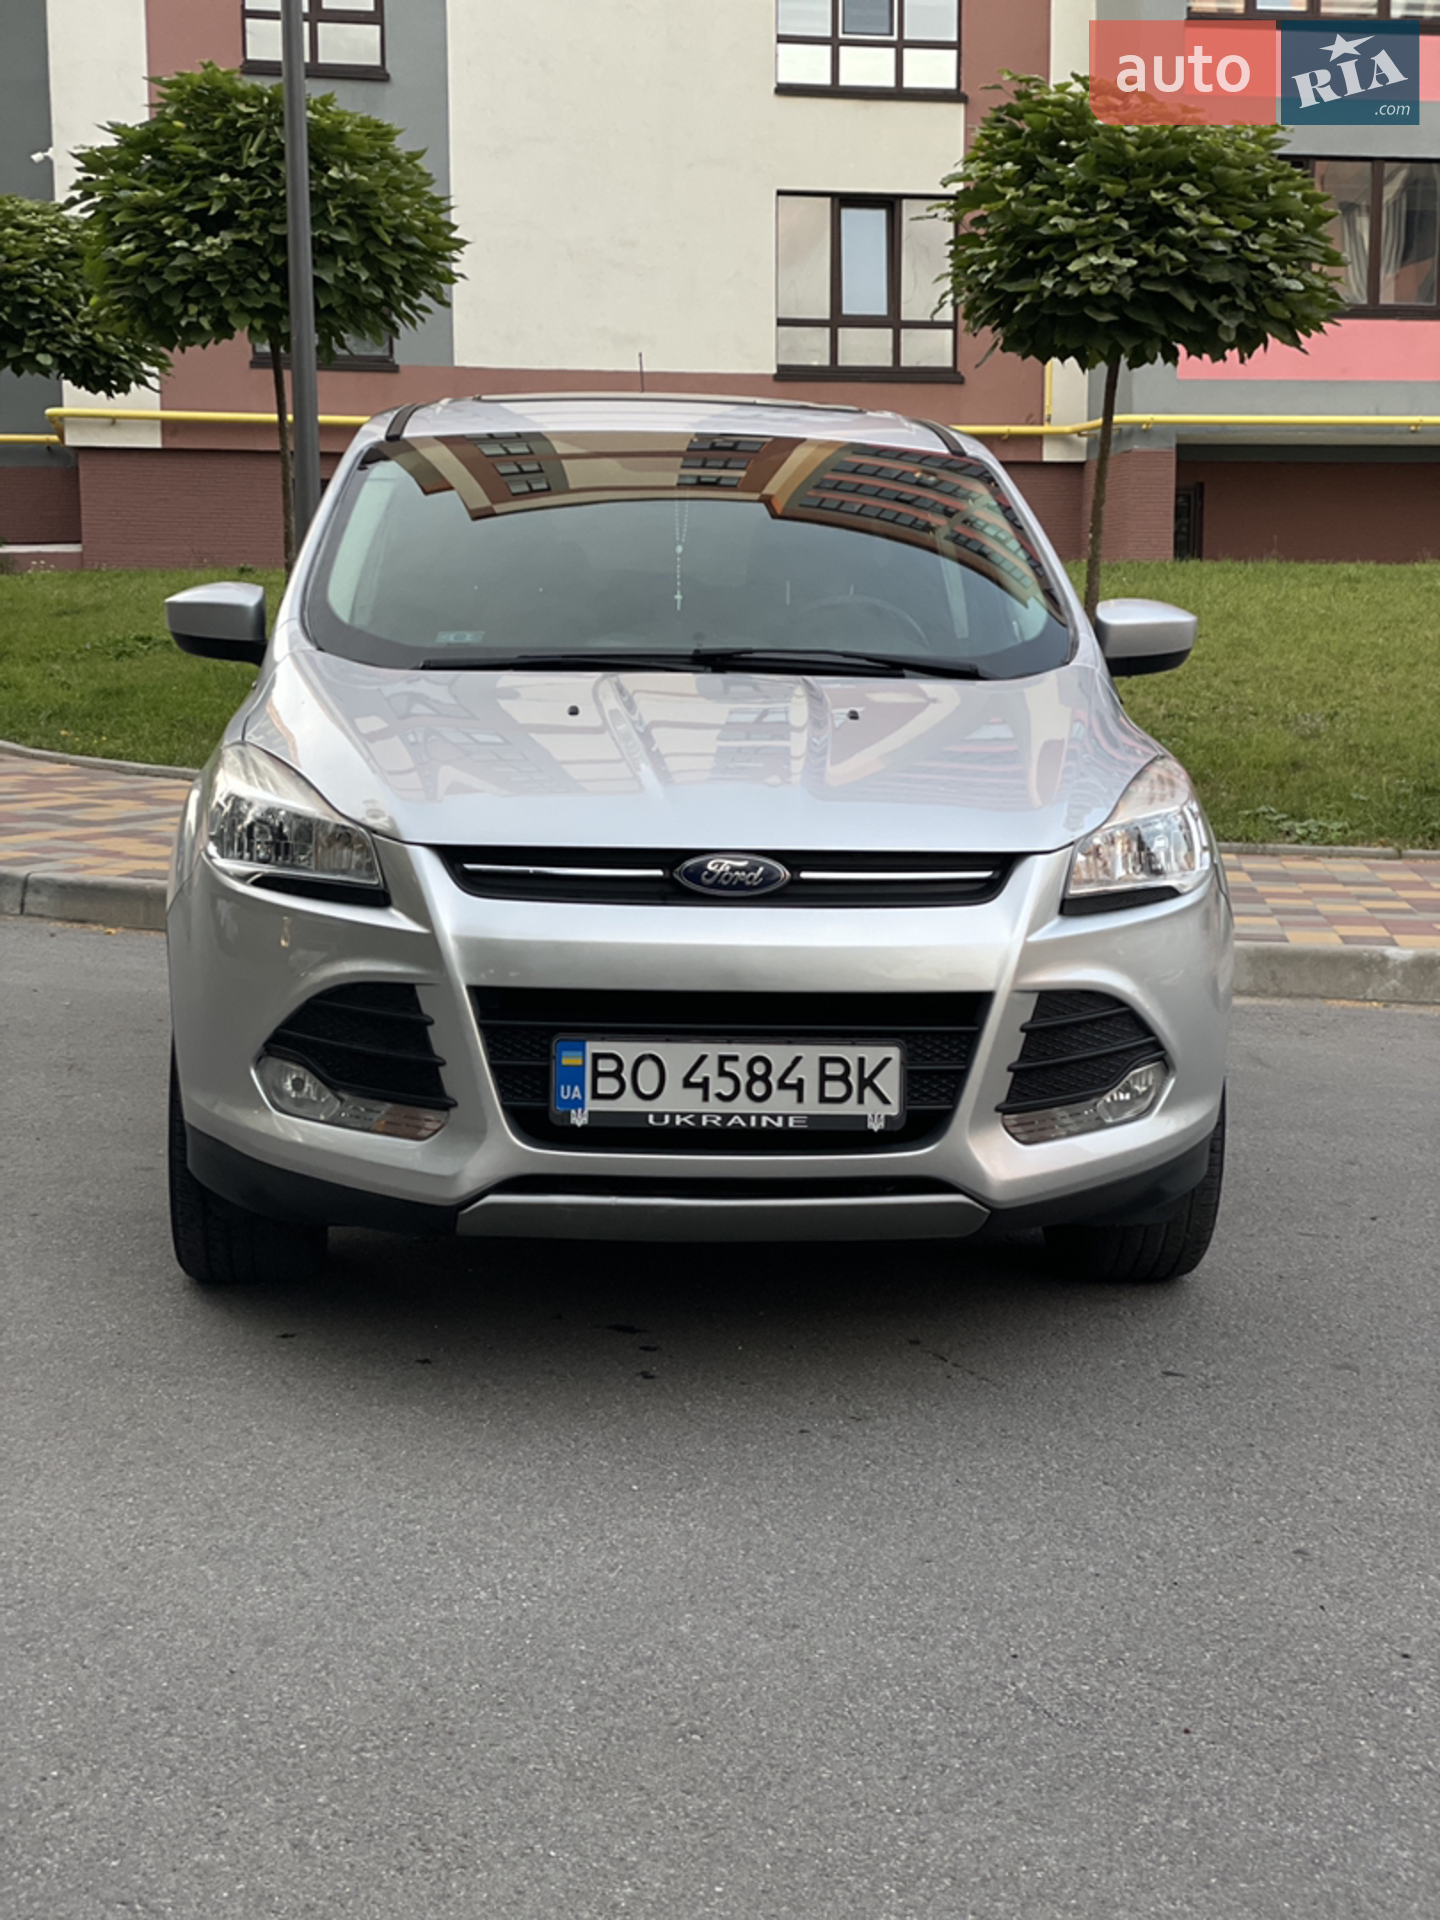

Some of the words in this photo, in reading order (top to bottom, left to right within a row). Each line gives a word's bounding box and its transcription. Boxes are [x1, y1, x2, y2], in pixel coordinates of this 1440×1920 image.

[700, 858, 764, 886] Ford
[590, 1051, 667, 1102] BO
[681, 1053, 805, 1104] 4584
[817, 1055, 893, 1106] BK
[560, 1084, 582, 1101] UA
[647, 1113, 809, 1128] UKRAINE
